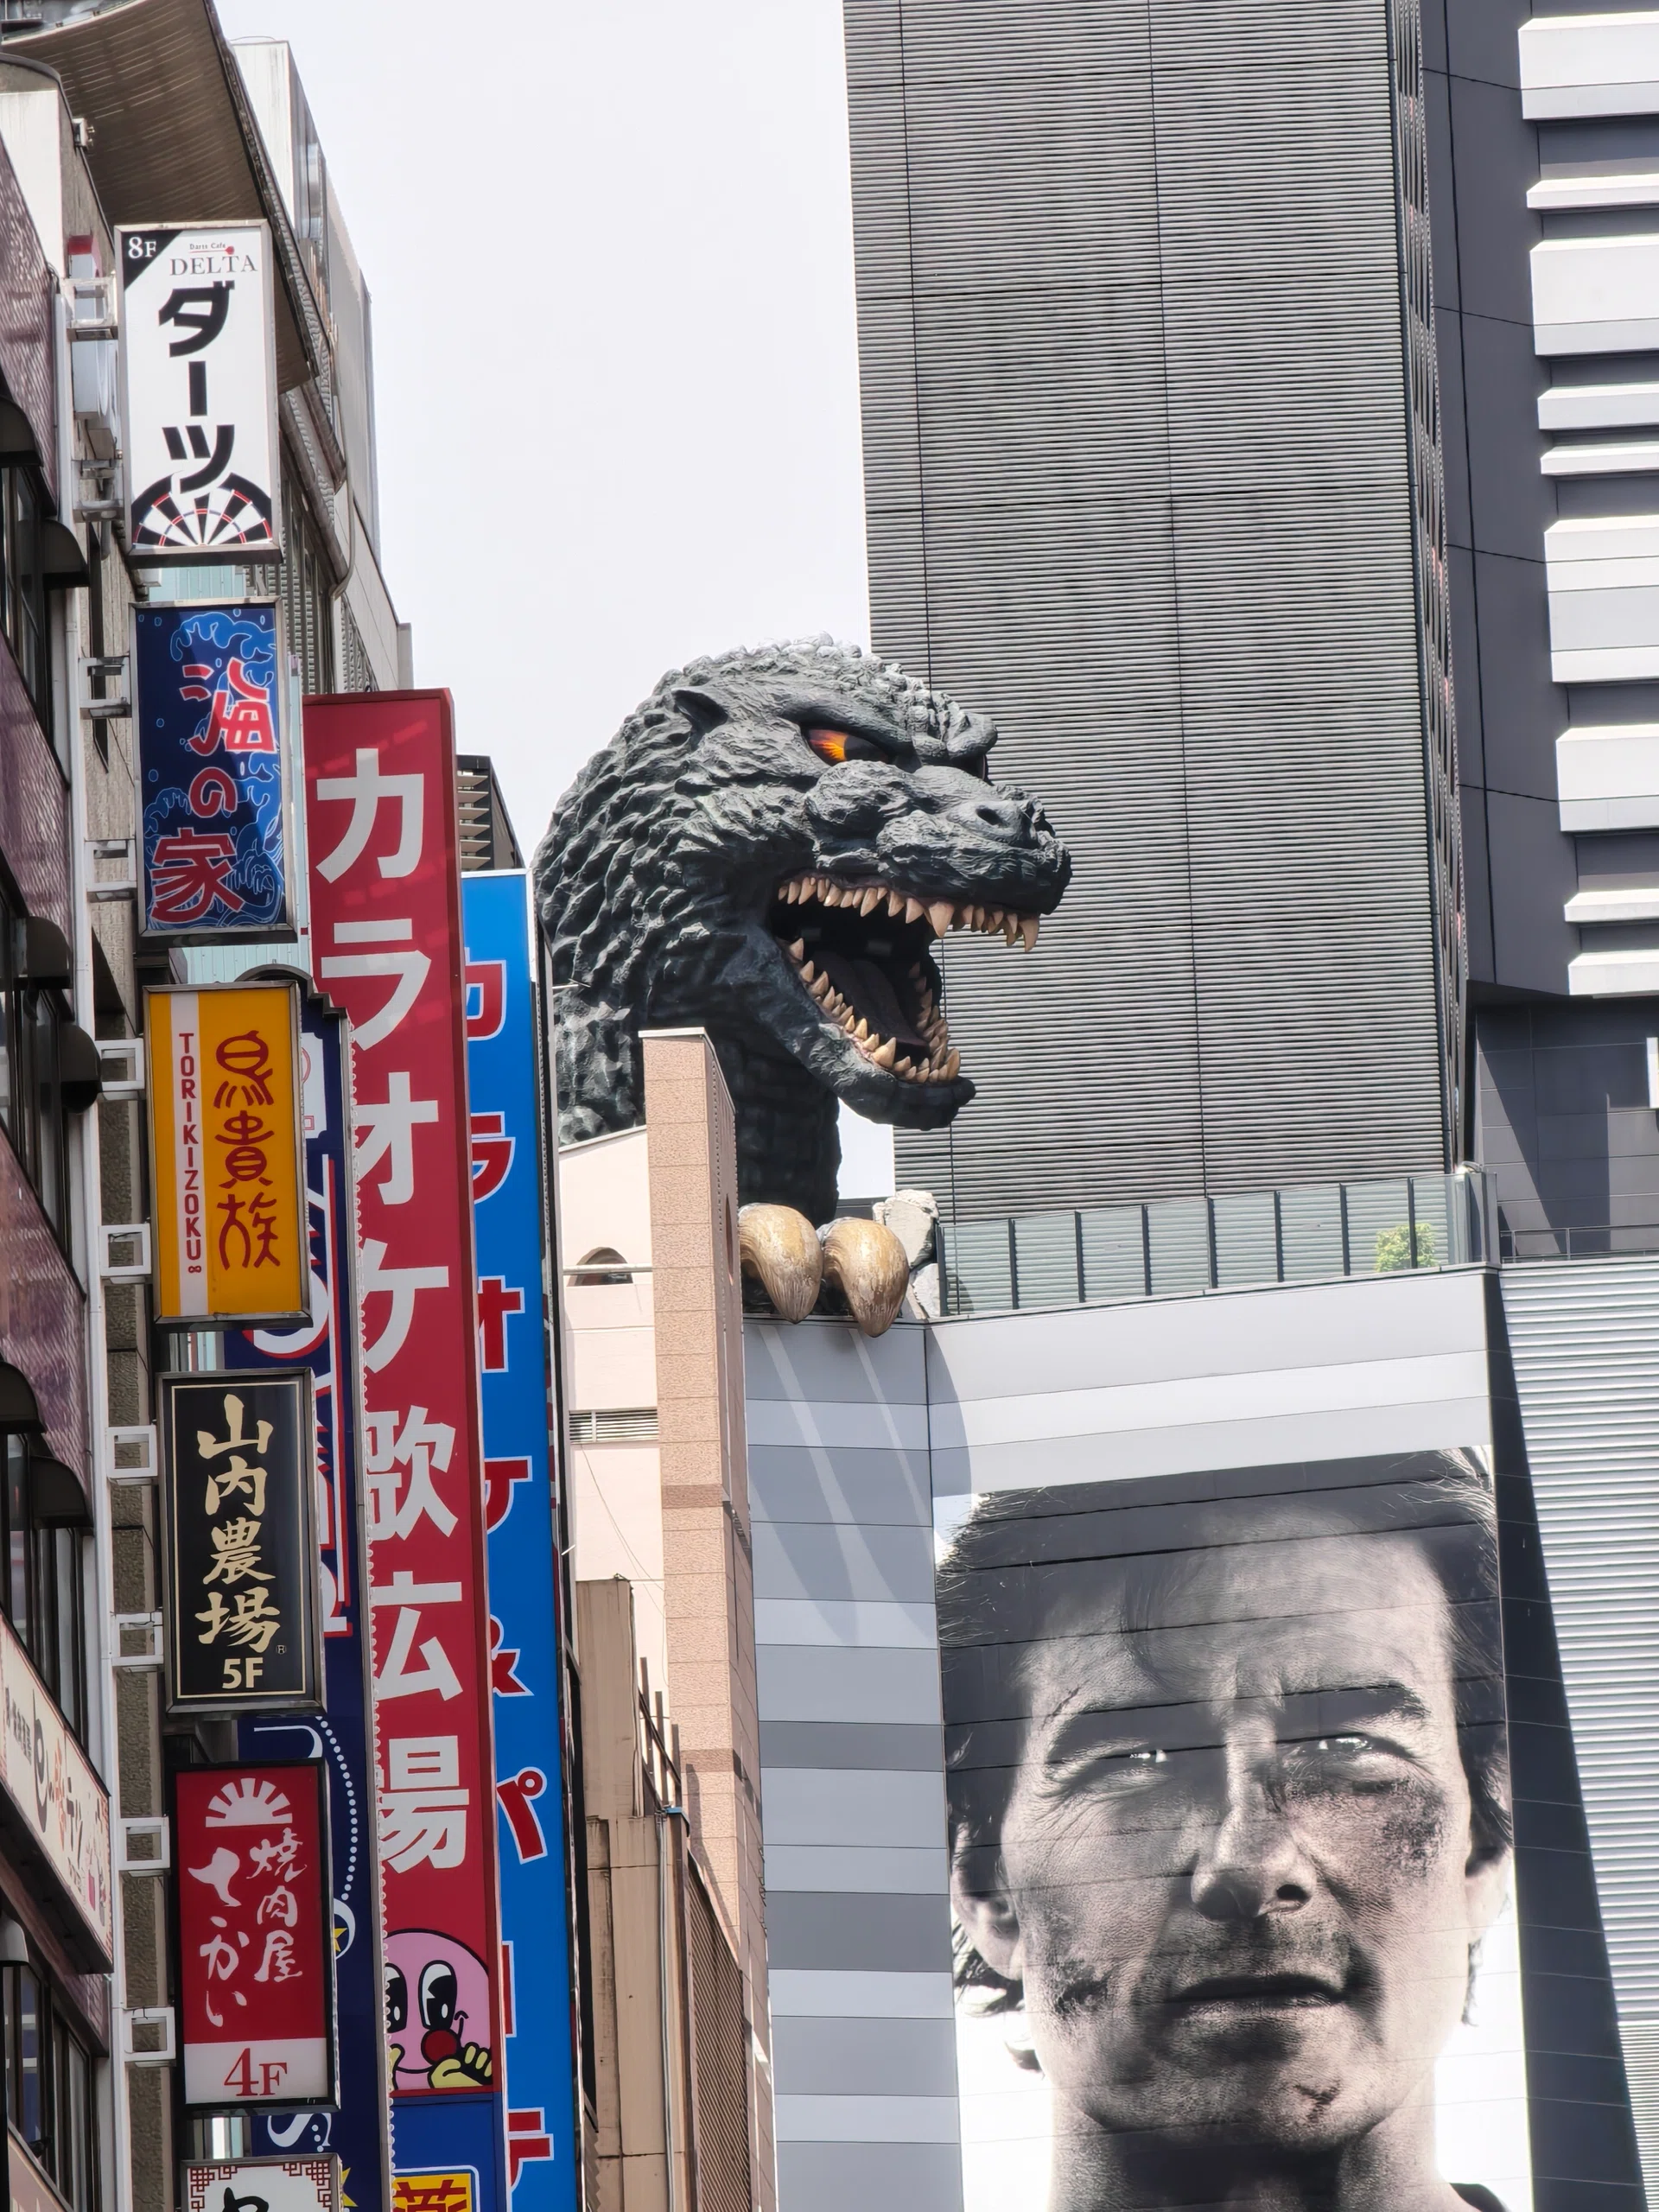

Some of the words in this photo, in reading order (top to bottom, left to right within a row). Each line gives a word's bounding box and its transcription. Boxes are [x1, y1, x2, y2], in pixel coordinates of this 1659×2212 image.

[128, 236, 157, 259] 8F
[169, 254, 259, 276] DELTA
[158, 280, 235, 495] ダーツ
[150, 657, 277, 924] 海の家
[213, 1030, 282, 1272] 鳥貴族
[195, 1394, 281, 1654] 山内農場
[221, 1657, 264, 1689] 5F
[188, 1847, 251, 2027] さかい
[246, 1827, 308, 1983] 焼肉屋
[223, 2047, 288, 2097] 4F
